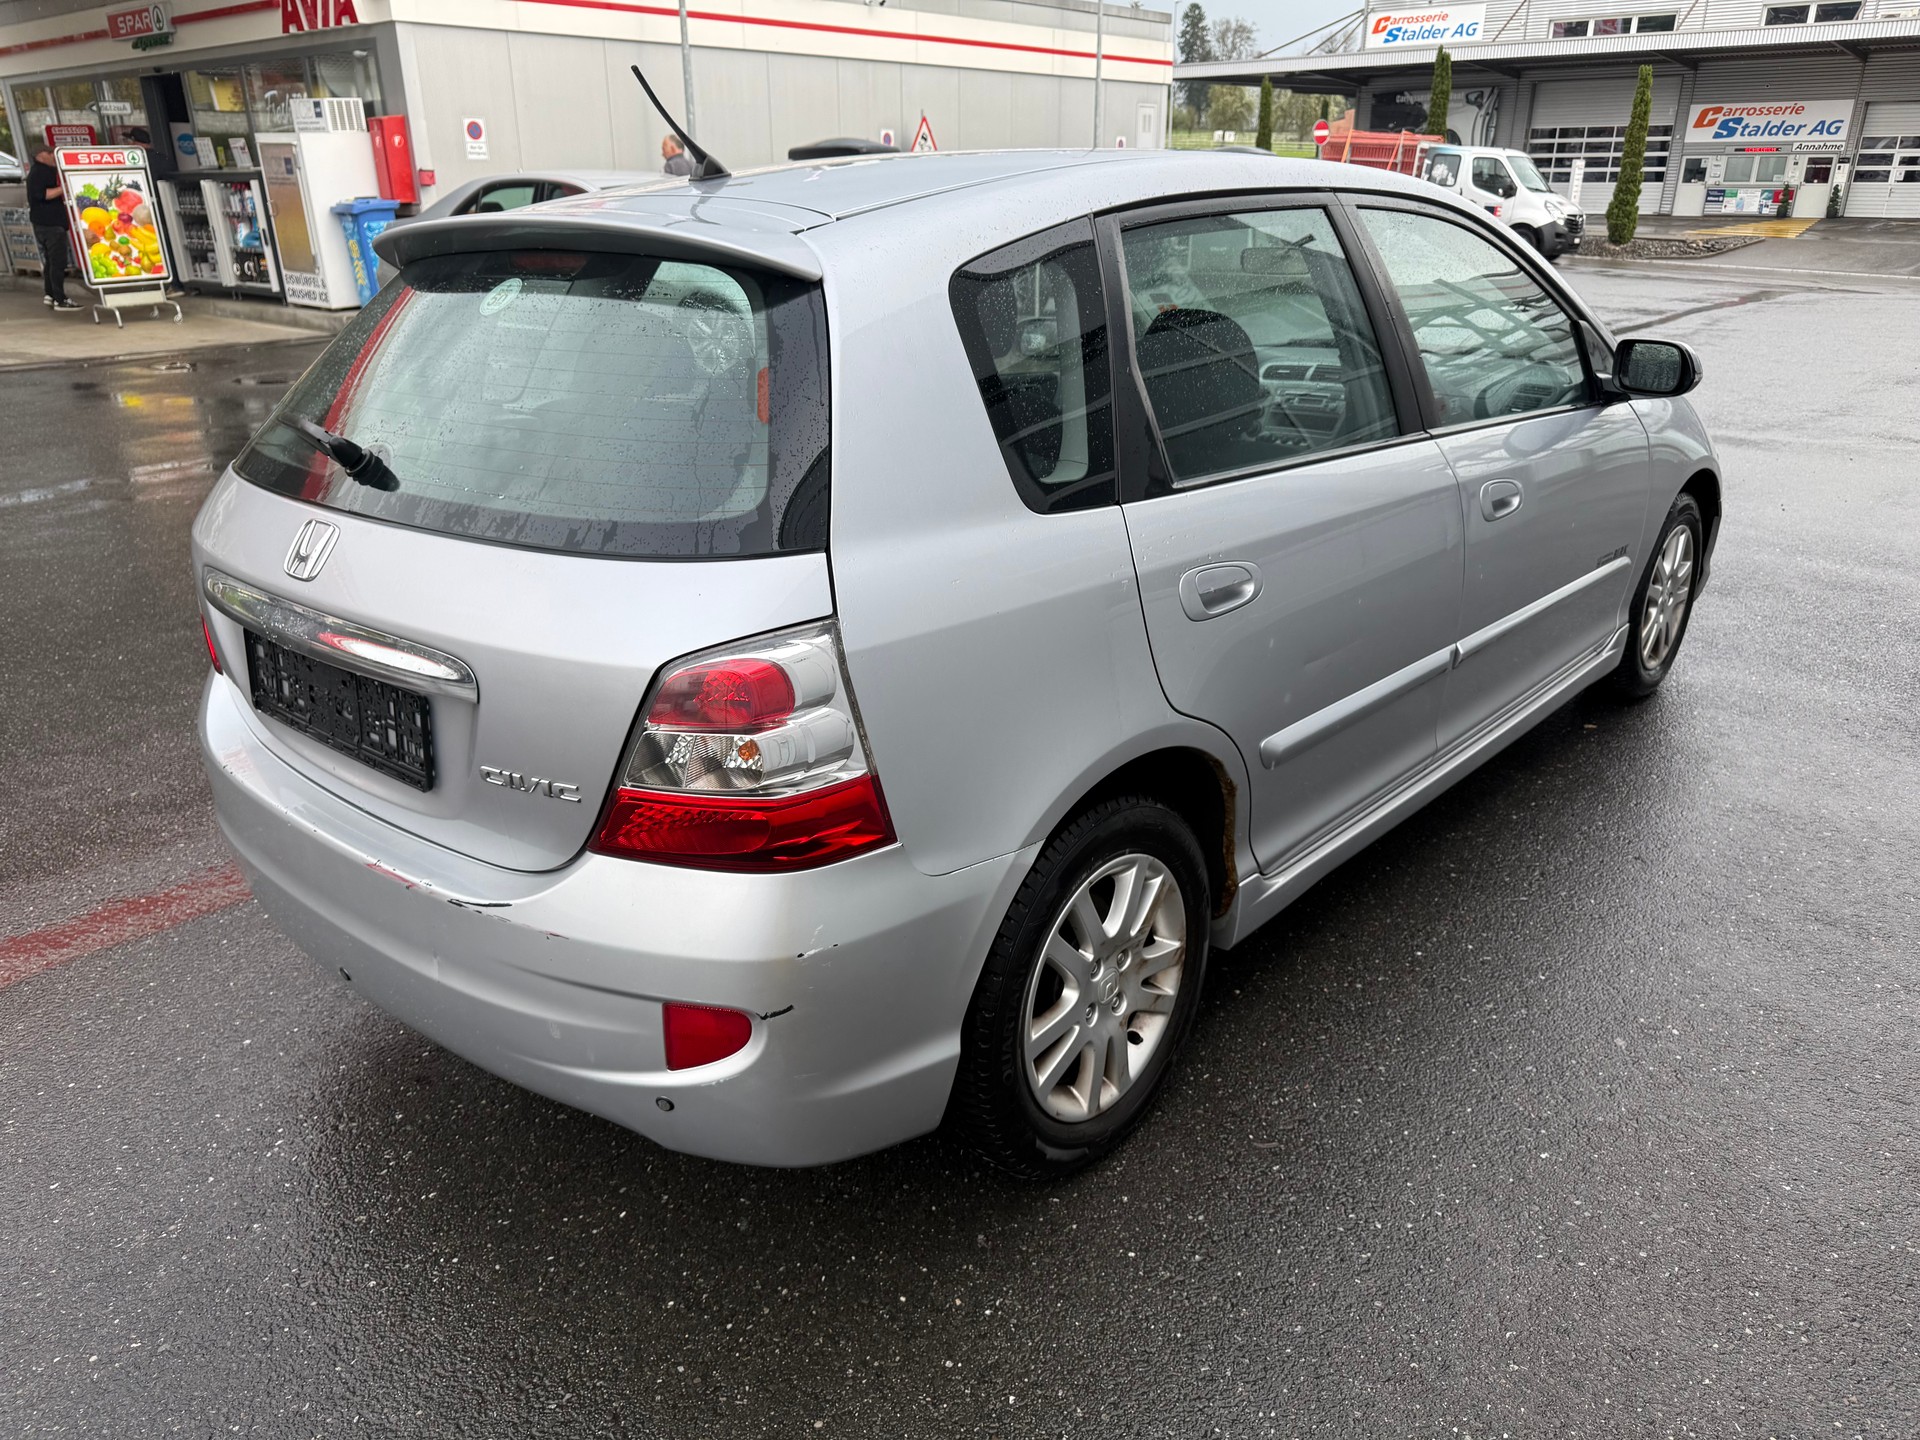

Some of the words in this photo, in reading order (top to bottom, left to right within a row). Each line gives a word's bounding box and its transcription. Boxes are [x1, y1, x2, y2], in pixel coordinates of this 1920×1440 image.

[117, 11, 151, 34] SPAR
[282, 0, 359, 34] AVIA
[1371, 11, 1449, 35] Carrosserie
[1383, 24, 1450, 43] Stalder
[1451, 22, 1479, 38] AG
[1692, 103, 1805, 129] Carrosserie
[1712, 117, 1807, 139] Stalder
[1808, 119, 1844, 136] AG
[1794, 142, 1844, 151] Annahme
[78, 154, 124, 164] SPAR
[287, 286, 318, 301] CRUSHED
[480, 765, 581, 803] CIVIC
